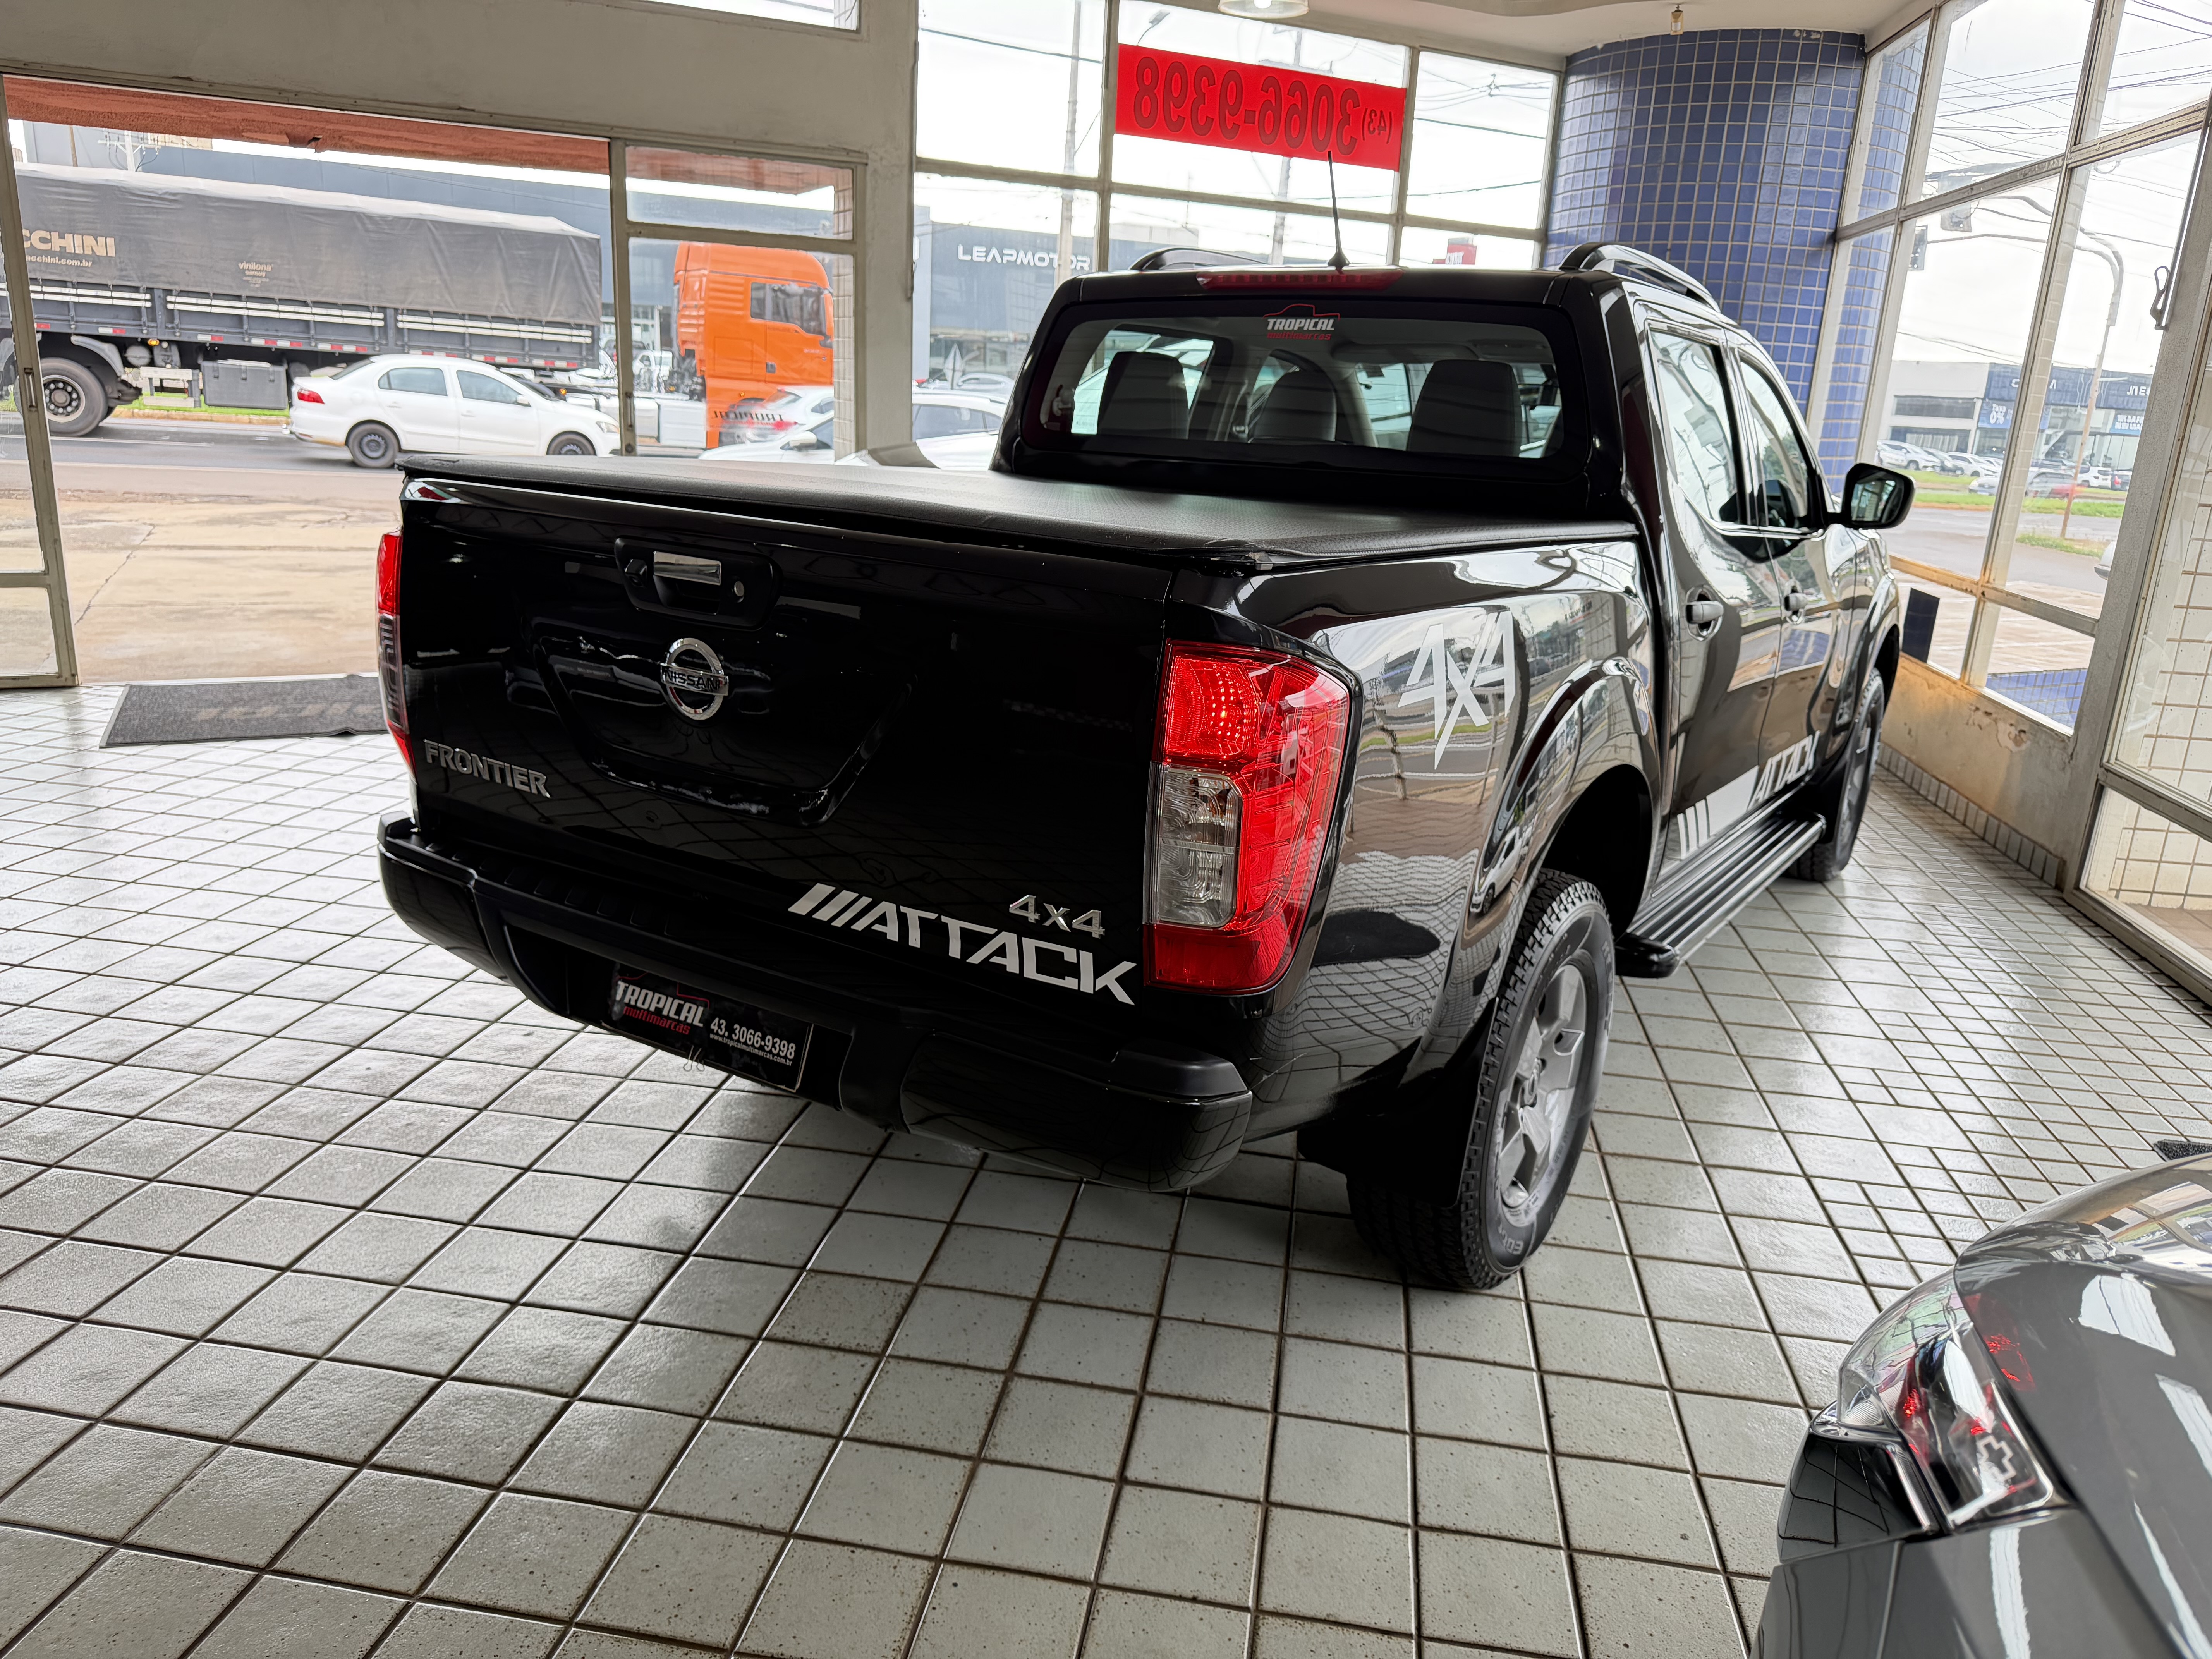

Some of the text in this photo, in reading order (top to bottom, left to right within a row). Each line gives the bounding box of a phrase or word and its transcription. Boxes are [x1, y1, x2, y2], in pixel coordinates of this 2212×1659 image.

[1267, 319, 1334, 330] TROPICAL
[1267, 331, 1332, 340] multimarcas
[665, 668, 720, 692] NISSAN
[423, 739, 551, 799] FRONTIER
[1747, 730, 1820, 811] ATTACK
[616, 981, 704, 1027] TROPICAL
[623, 1006, 691, 1035] multimarcas
[709, 1033, 793, 1066] www.tropicalmultimarcas.com.br
[710, 1017, 796, 1059] 43. 3066-9398
